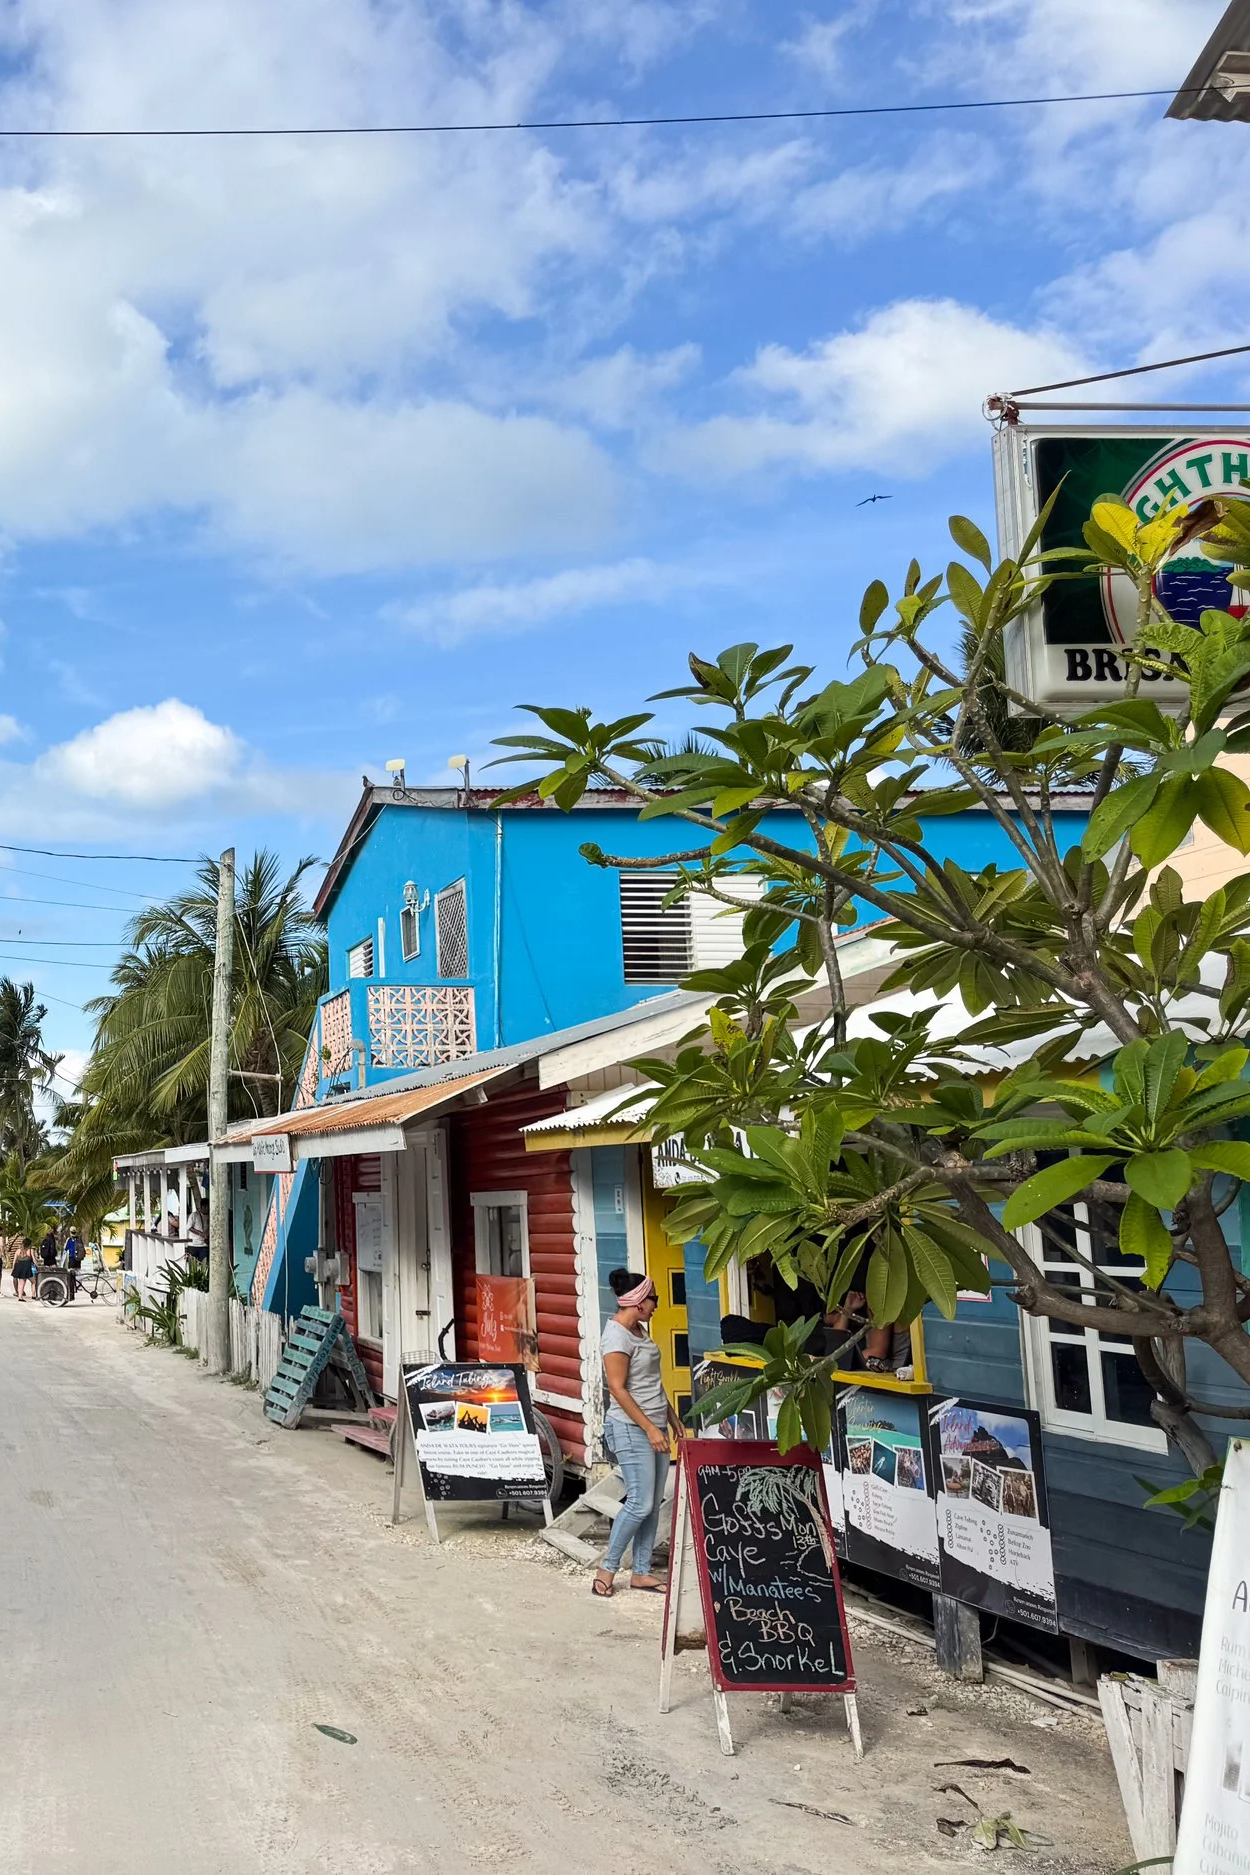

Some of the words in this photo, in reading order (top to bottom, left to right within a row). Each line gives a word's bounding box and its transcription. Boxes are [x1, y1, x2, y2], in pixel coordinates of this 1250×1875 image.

[1135, 452, 1248, 525] GHTH
[420, 1374, 456, 1391] Island
[457, 1372, 491, 1390] Tubing
[701, 1492, 782, 1540] Goffs
[780, 1514, 817, 1536] Mon
[704, 1534, 766, 1578] Caye
[724, 1597, 796, 1625] Beach
[748, 1619, 816, 1648] BBQ
